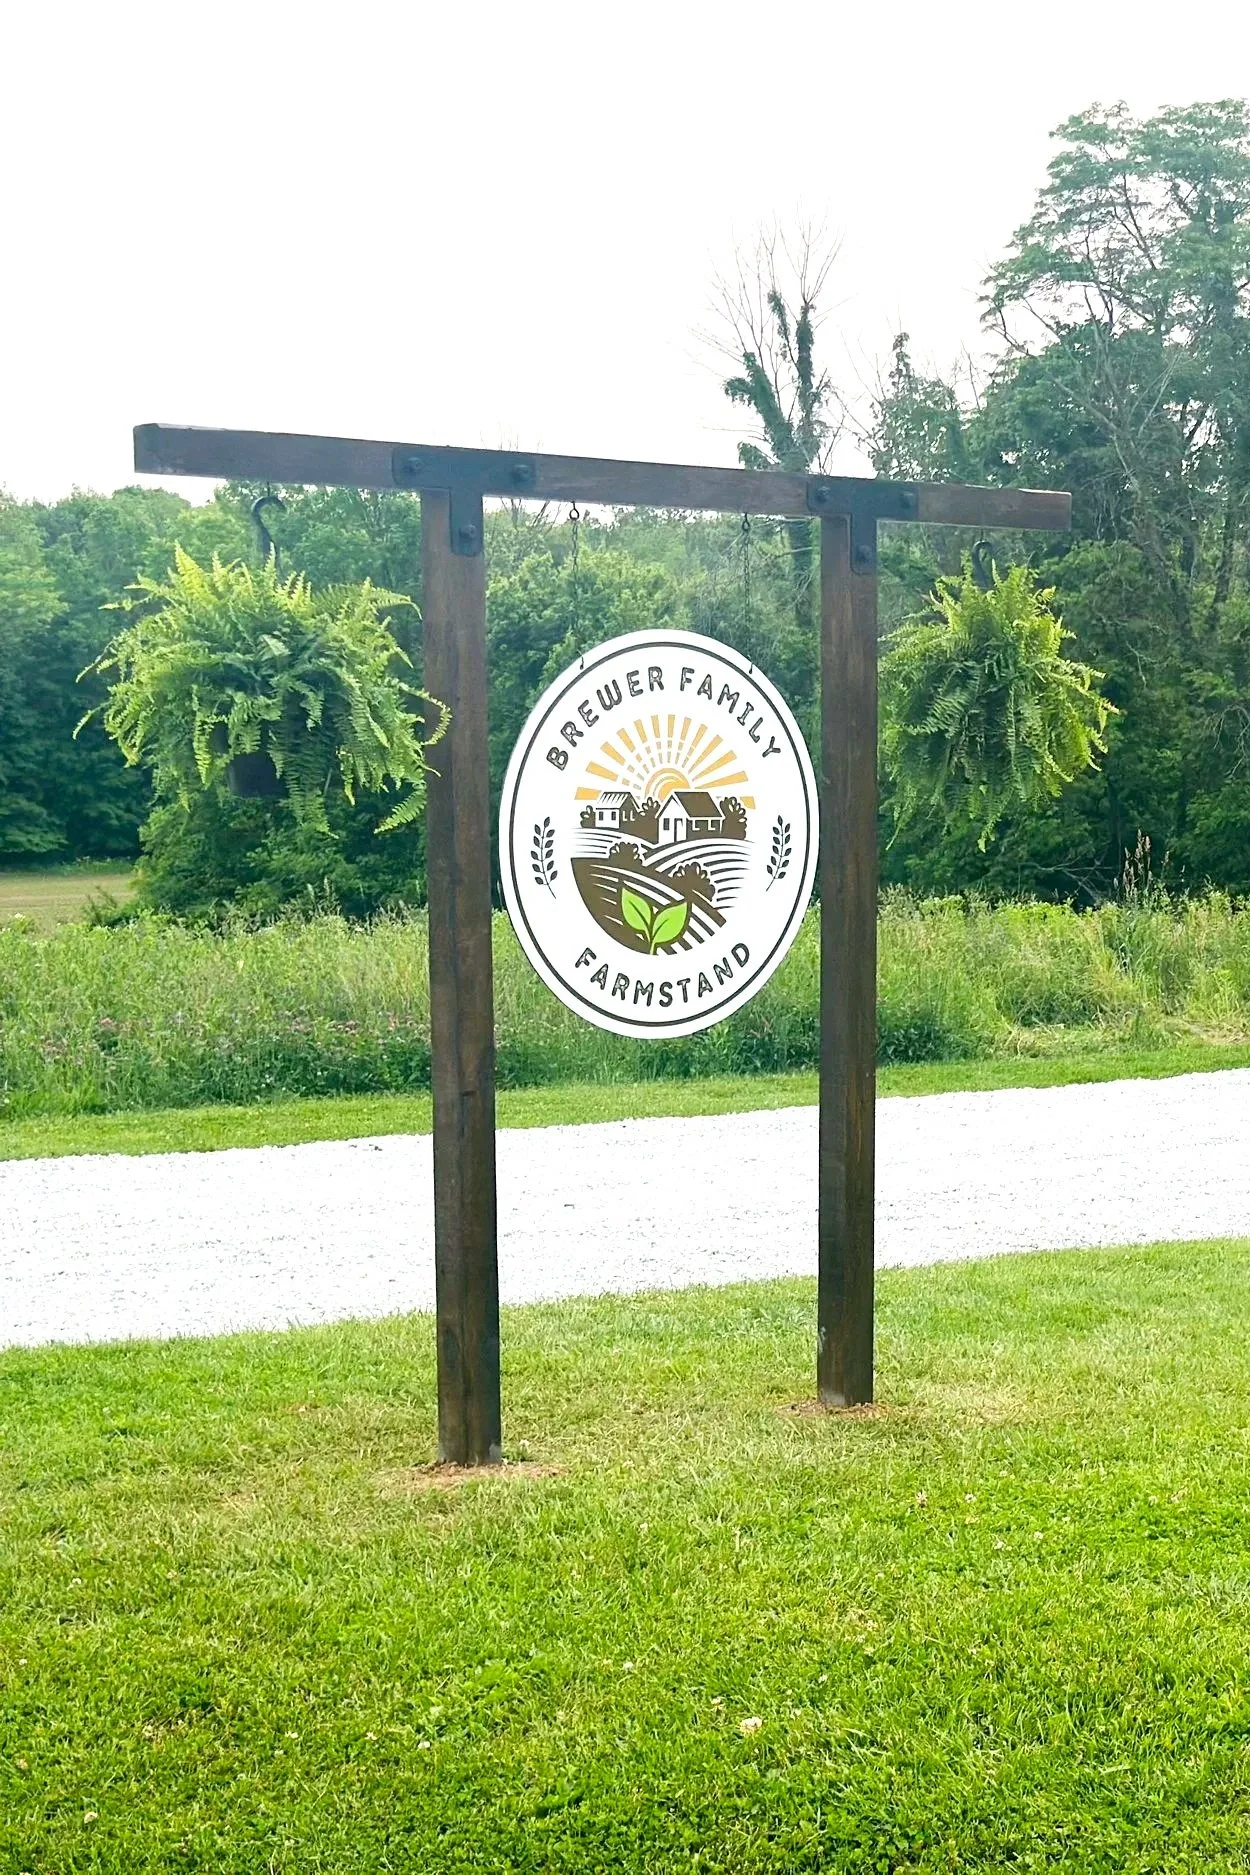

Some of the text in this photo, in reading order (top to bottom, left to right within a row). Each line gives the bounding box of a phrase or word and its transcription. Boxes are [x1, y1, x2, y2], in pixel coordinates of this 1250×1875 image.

[546, 666, 782, 771] BREWER FAMILY
[574, 942, 751, 1008] FARMSTAND
